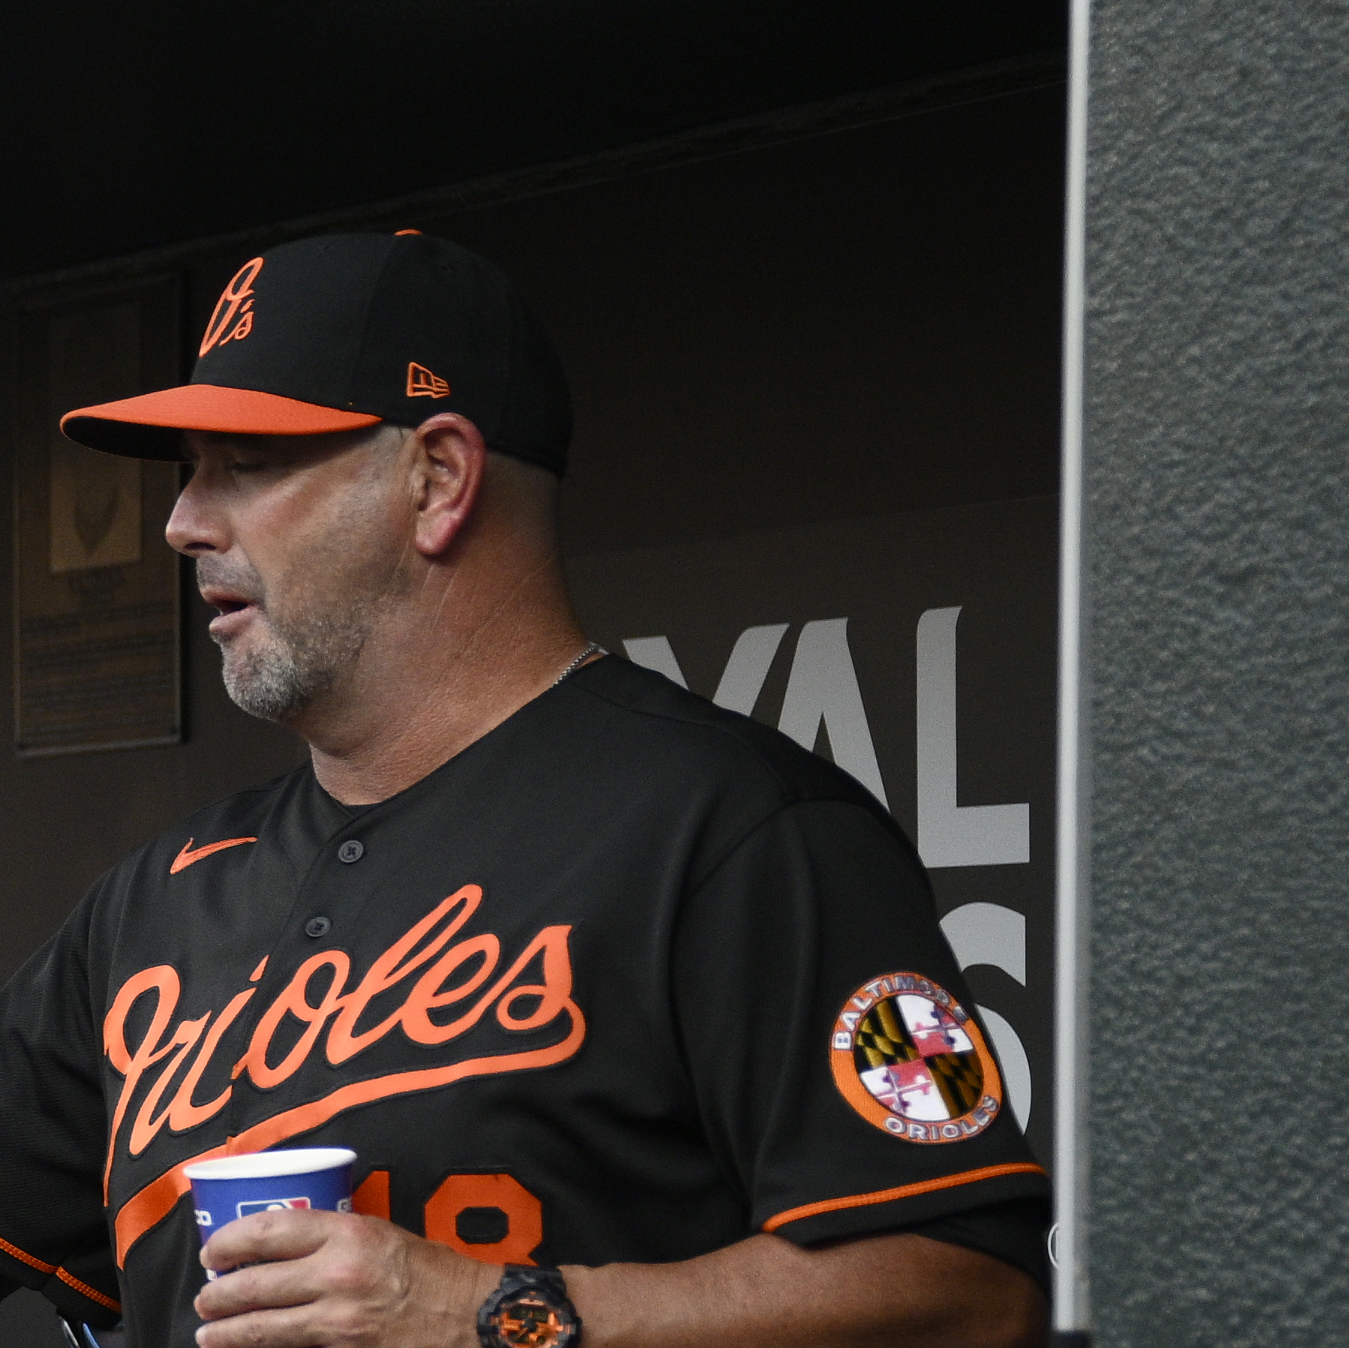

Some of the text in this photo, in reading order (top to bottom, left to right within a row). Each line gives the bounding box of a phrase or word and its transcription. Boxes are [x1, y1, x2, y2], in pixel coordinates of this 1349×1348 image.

[103, 883, 587, 1206] Orioles
[833, 976, 969, 1050] BALTIMORE
[884, 1095, 999, 1141] ORIOLES
